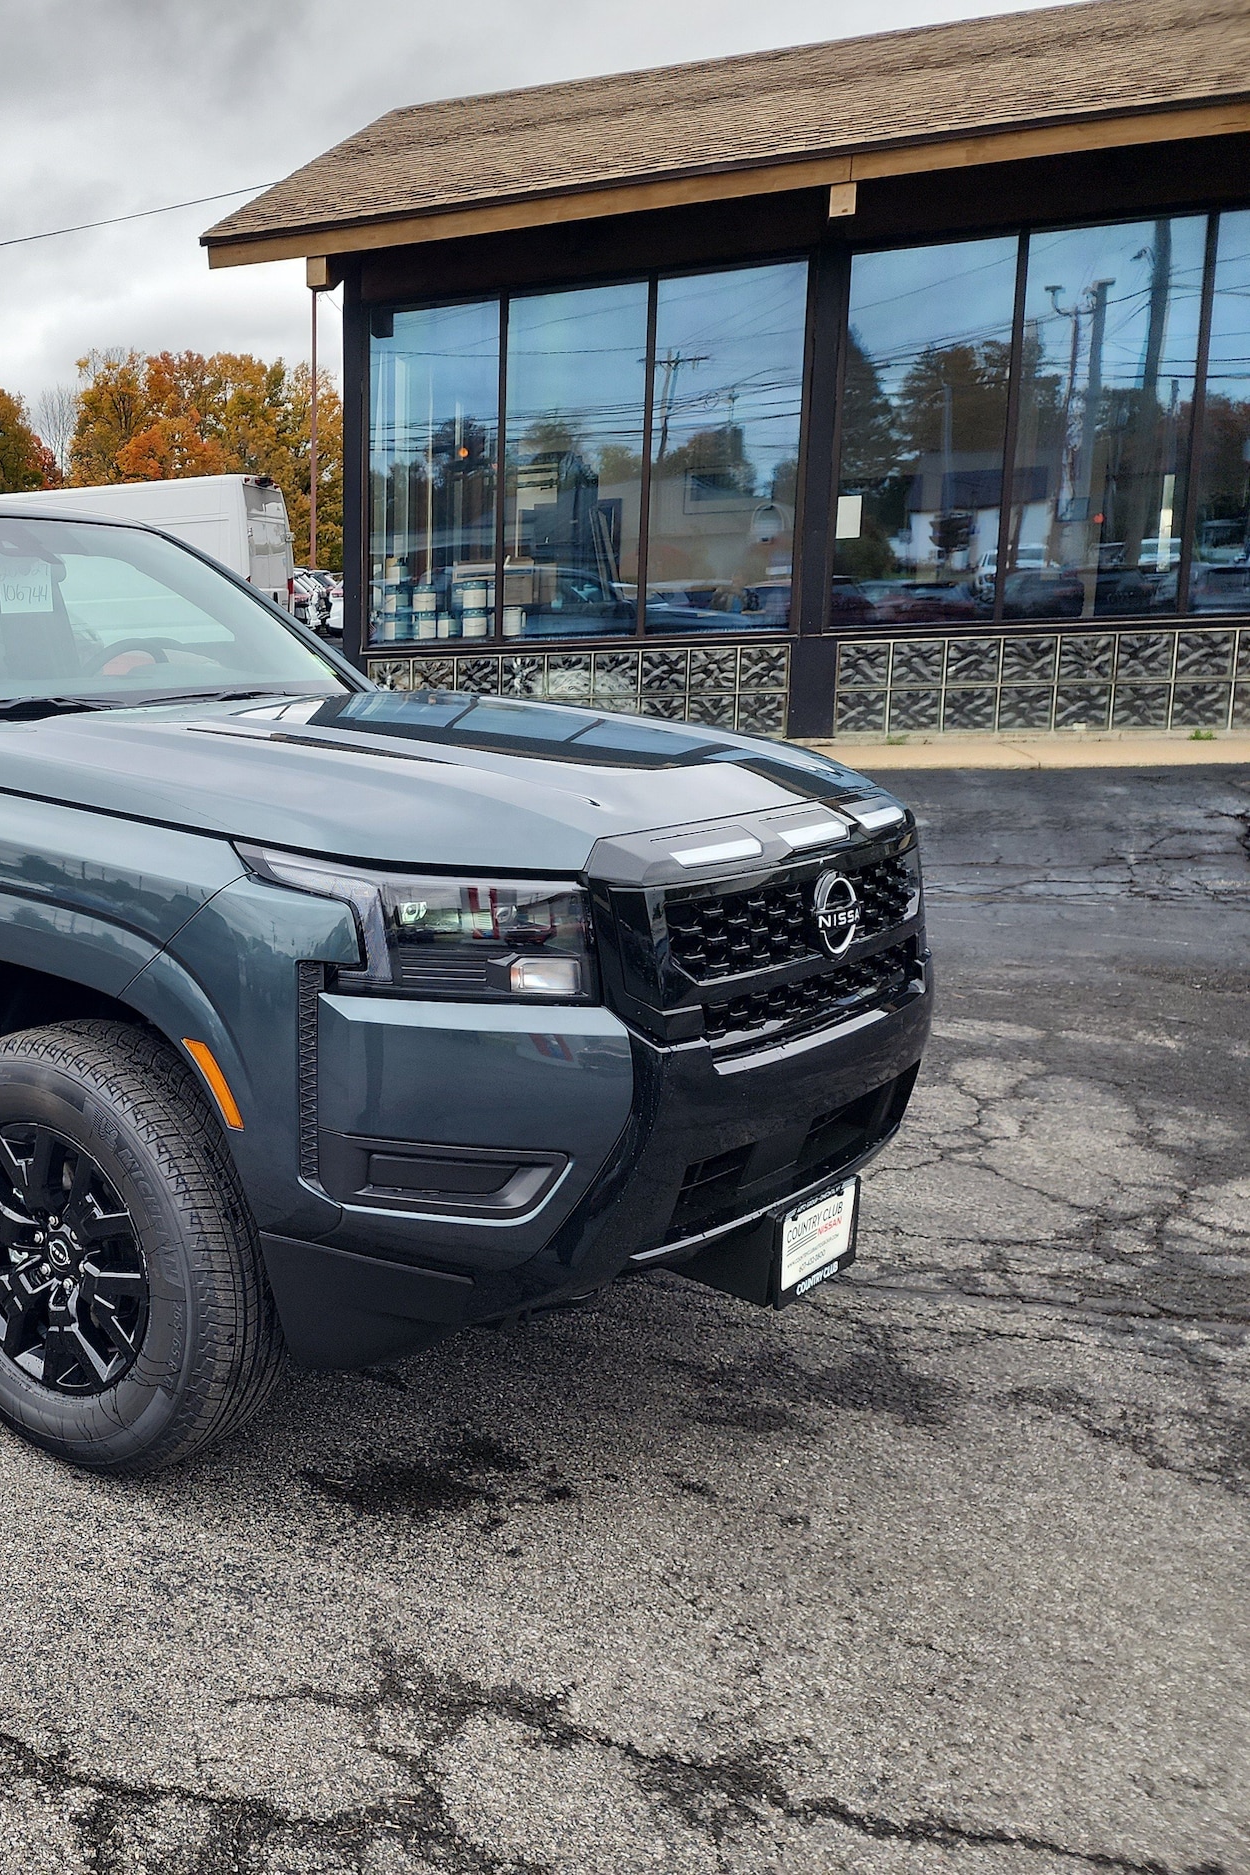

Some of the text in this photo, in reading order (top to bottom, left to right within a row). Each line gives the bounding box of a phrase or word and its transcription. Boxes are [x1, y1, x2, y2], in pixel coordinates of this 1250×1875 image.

[2, 583, 49, 605] 106744
[818, 907, 860, 929] NISSA
[787, 1201, 844, 1244] COUNTRY CLUB
[817, 1215, 843, 1236] NISSAN
[796, 1269, 824, 1296] COUNTRY
[823, 1260, 839, 1279] CLUB
